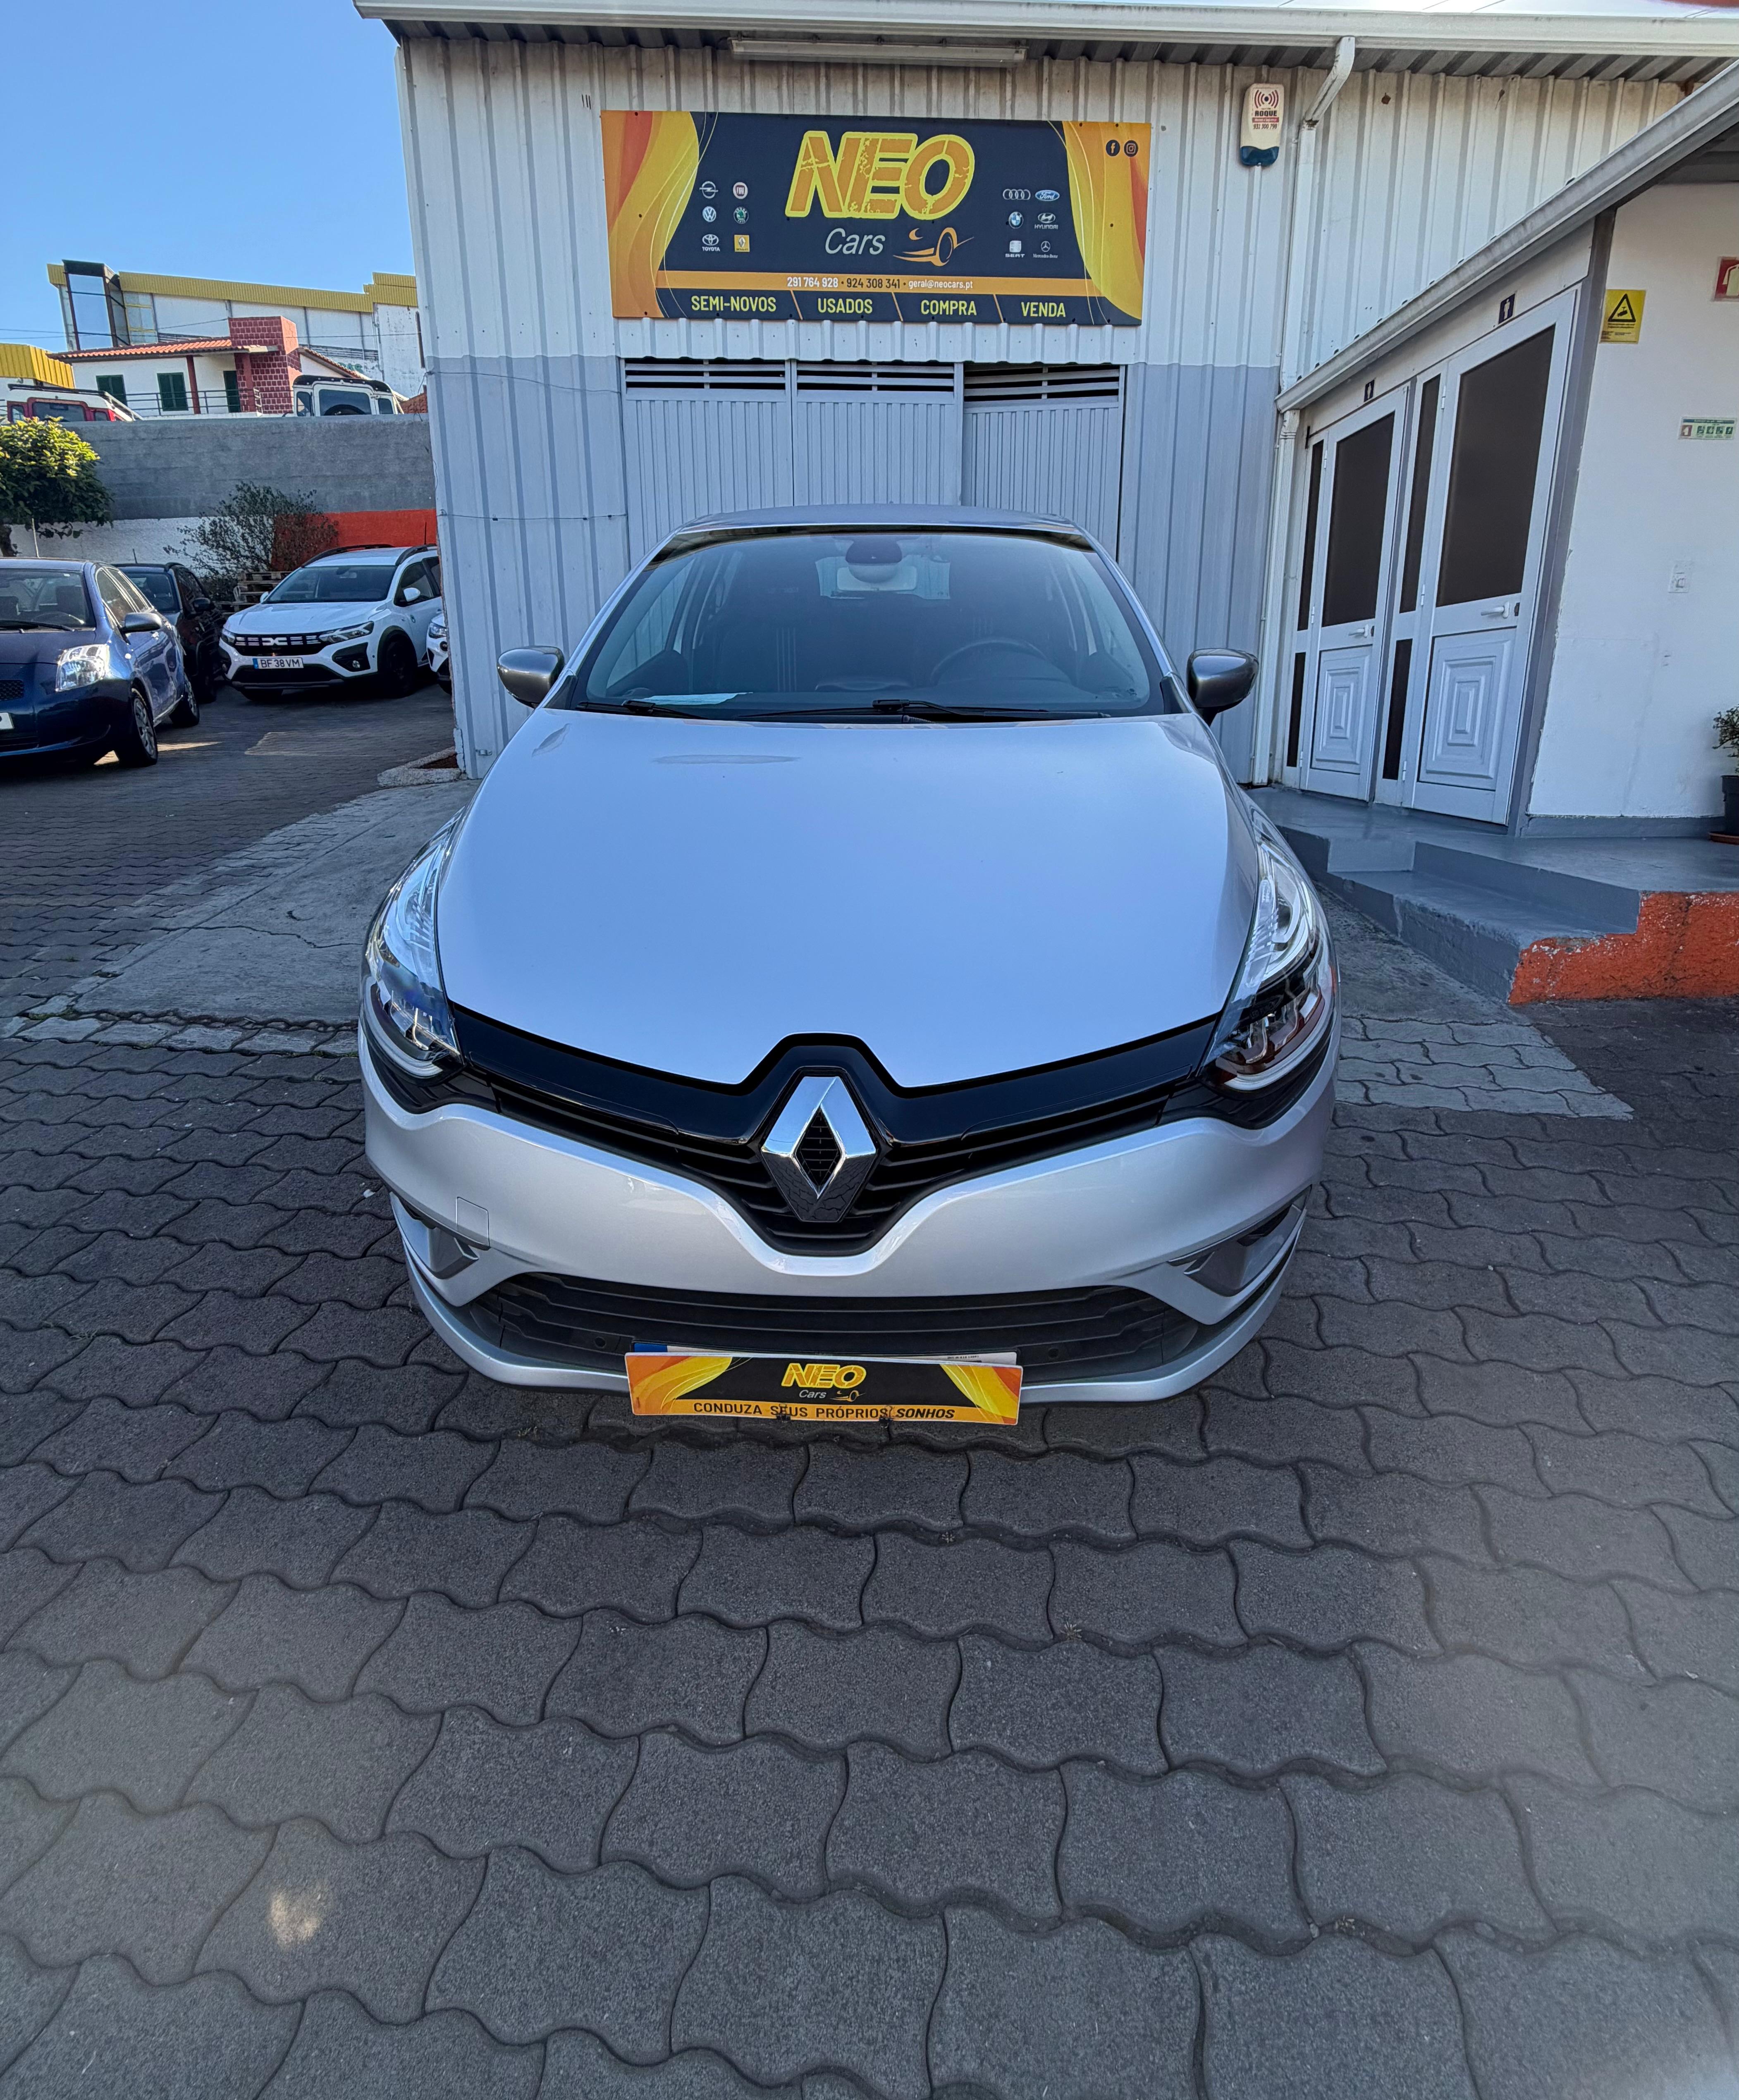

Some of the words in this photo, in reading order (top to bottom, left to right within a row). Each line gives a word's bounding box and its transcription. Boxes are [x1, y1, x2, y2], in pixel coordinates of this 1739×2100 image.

[785, 131, 975, 220] NEO
[1039, 191, 1056, 200] Ford
[824, 228, 885, 255] Cars
[787, 277, 801, 287] 291
[803, 277, 820, 287] 764
[822, 277, 838, 288] 928
[846, 278, 863, 289] 924
[866, 278, 883, 289] 308
[886, 278, 901, 289] 341
[908, 279, 973, 290] geral@neocars.pt
[691, 295, 777, 312] SEMI-NOVOS
[817, 298, 873, 314] USADOS
[921, 300, 977, 315] COMPRA
[1021, 302, 1066, 317] VENDA
[260, 659, 272, 668] BF
[781, 1363, 867, 1389] NEO
[799, 1390, 827, 1398] Cars
[693, 1402, 762, 1415] CONDUZA
[770, 1406, 808, 1418] SEUS
[816, 1406, 888, 1419] PRÓPRIOS
[896, 1408, 955, 1419] SONHOS
